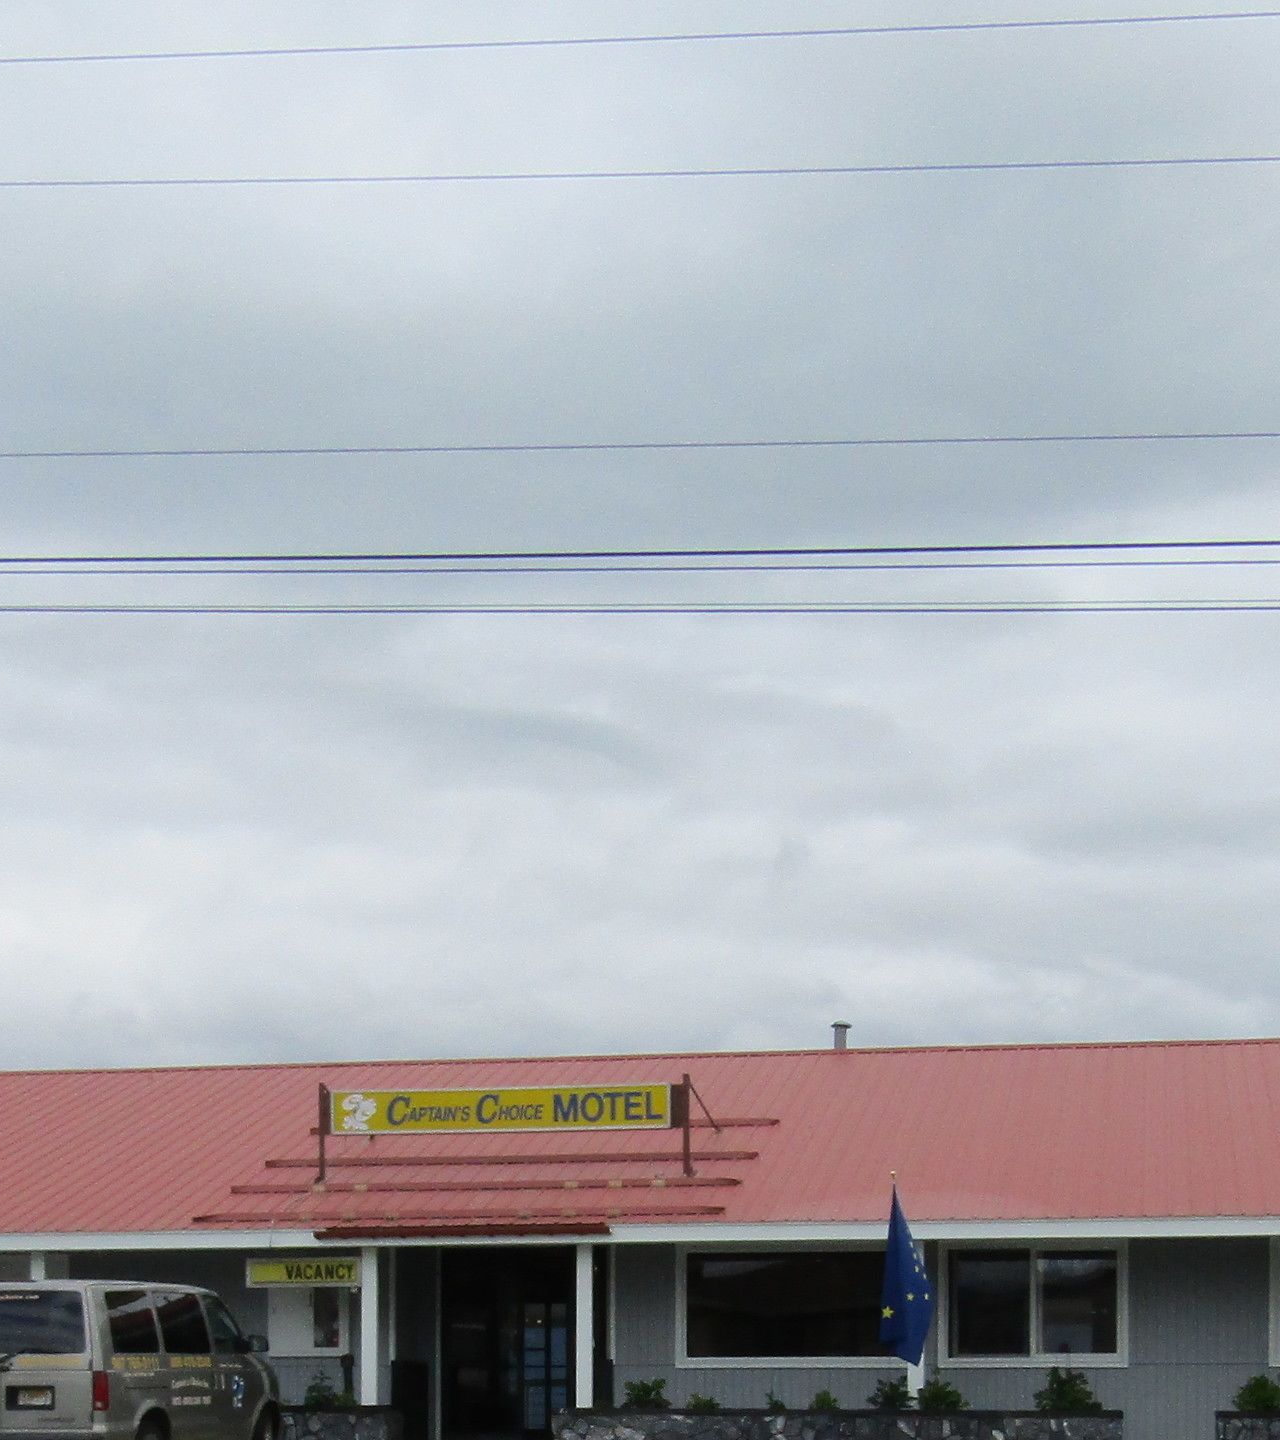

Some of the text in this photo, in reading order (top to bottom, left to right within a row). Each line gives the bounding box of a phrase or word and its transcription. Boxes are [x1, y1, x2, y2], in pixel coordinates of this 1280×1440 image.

[386, 1091, 663, 1126] CAPTAIN'S CHOICE MOTEL
[285, 1264, 354, 1280] VACANCY
